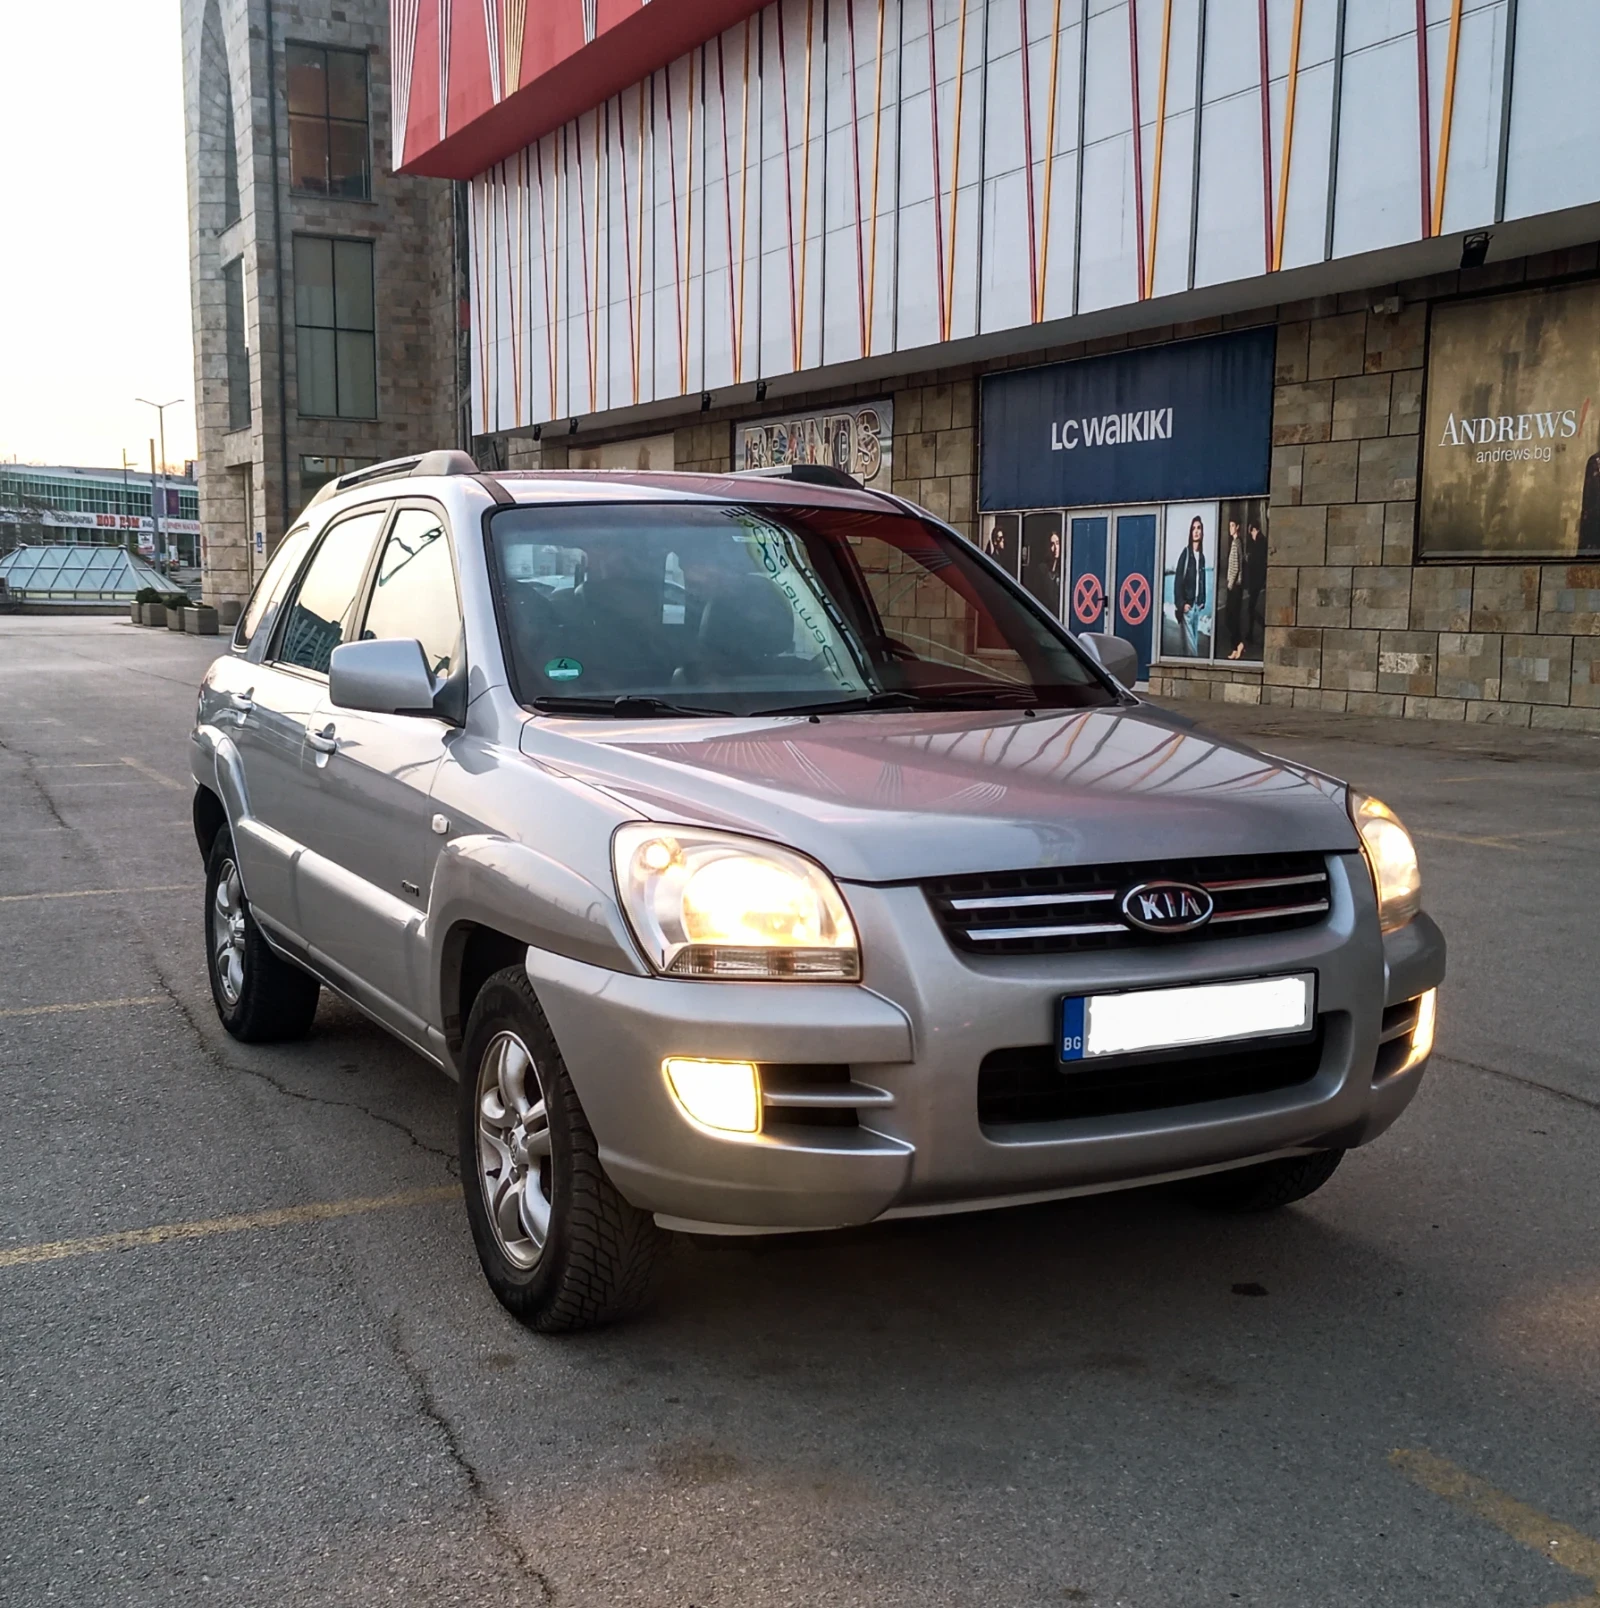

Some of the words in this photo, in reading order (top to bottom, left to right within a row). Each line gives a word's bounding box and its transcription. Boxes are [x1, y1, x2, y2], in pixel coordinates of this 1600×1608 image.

[1051, 419, 1079, 450] LC
[1438, 409, 1577, 446] ANDREWS
[743, 409, 881, 480] BRANDS
[1476, 444, 1551, 463] andrews.bg
[557, 658, 569, 670] 4
[1137, 891, 1202, 920] KIA
[1063, 1036, 1082, 1051] BG
